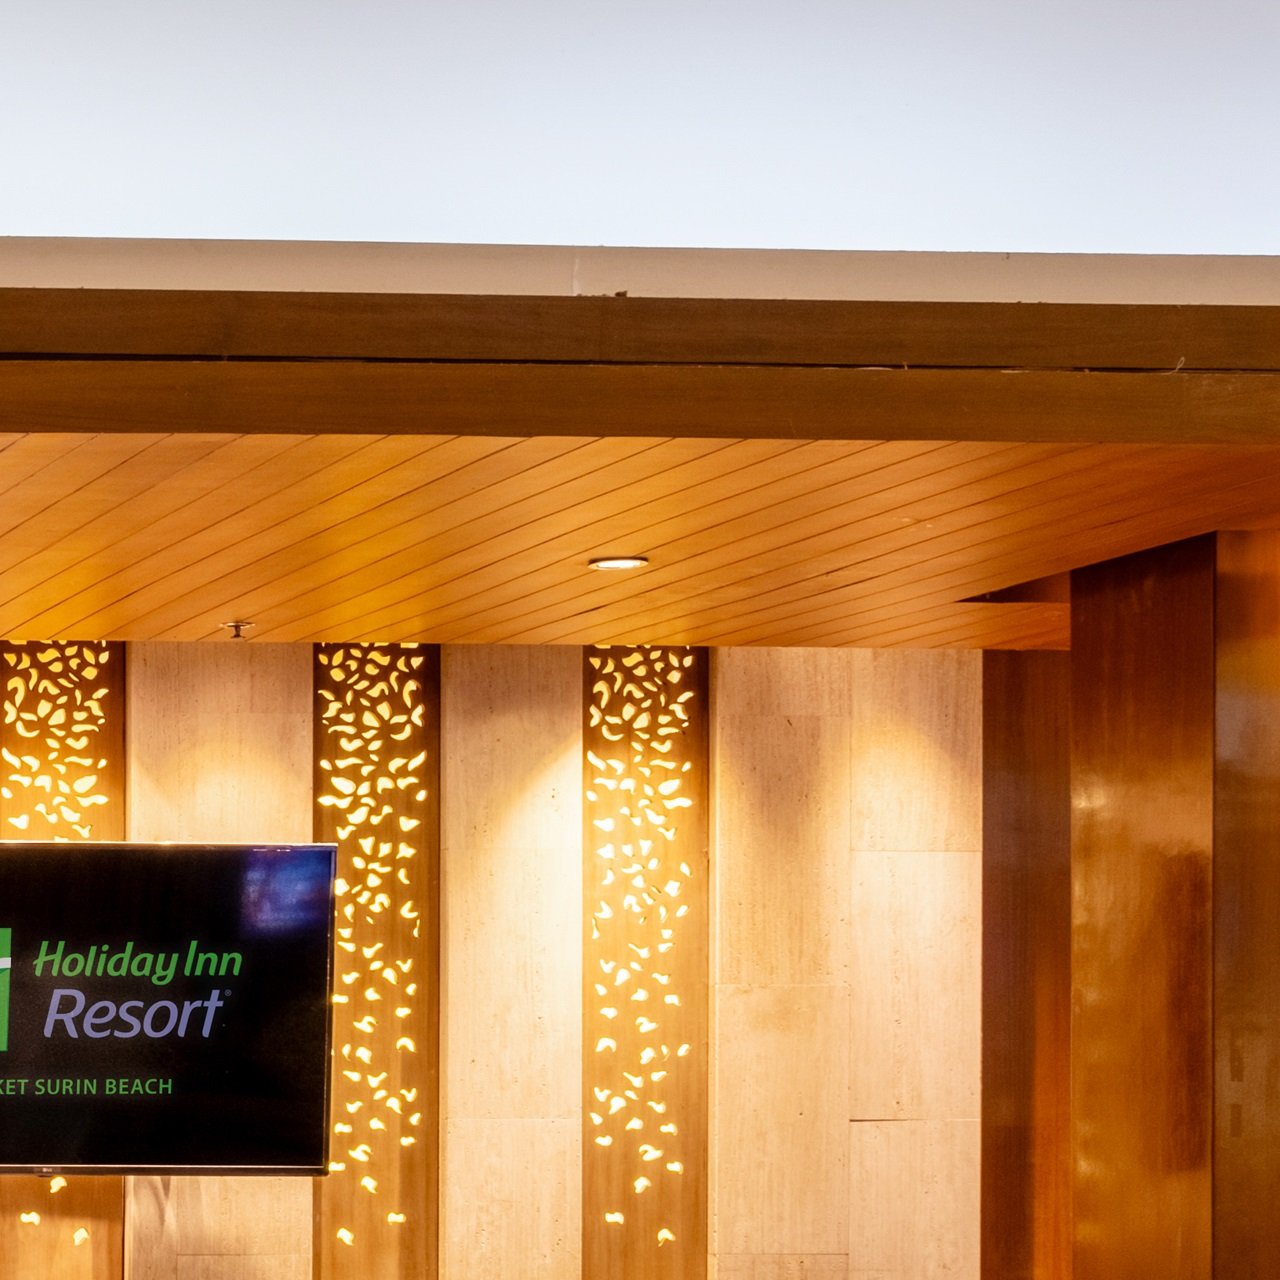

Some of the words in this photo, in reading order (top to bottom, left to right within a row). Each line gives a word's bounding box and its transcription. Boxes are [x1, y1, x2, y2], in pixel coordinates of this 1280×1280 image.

[33, 940, 179, 986] Holiday
[183, 940, 243, 976] Inn
[34, 1079, 97, 1095] SURIN
[105, 1078, 173, 1095] BEACH
